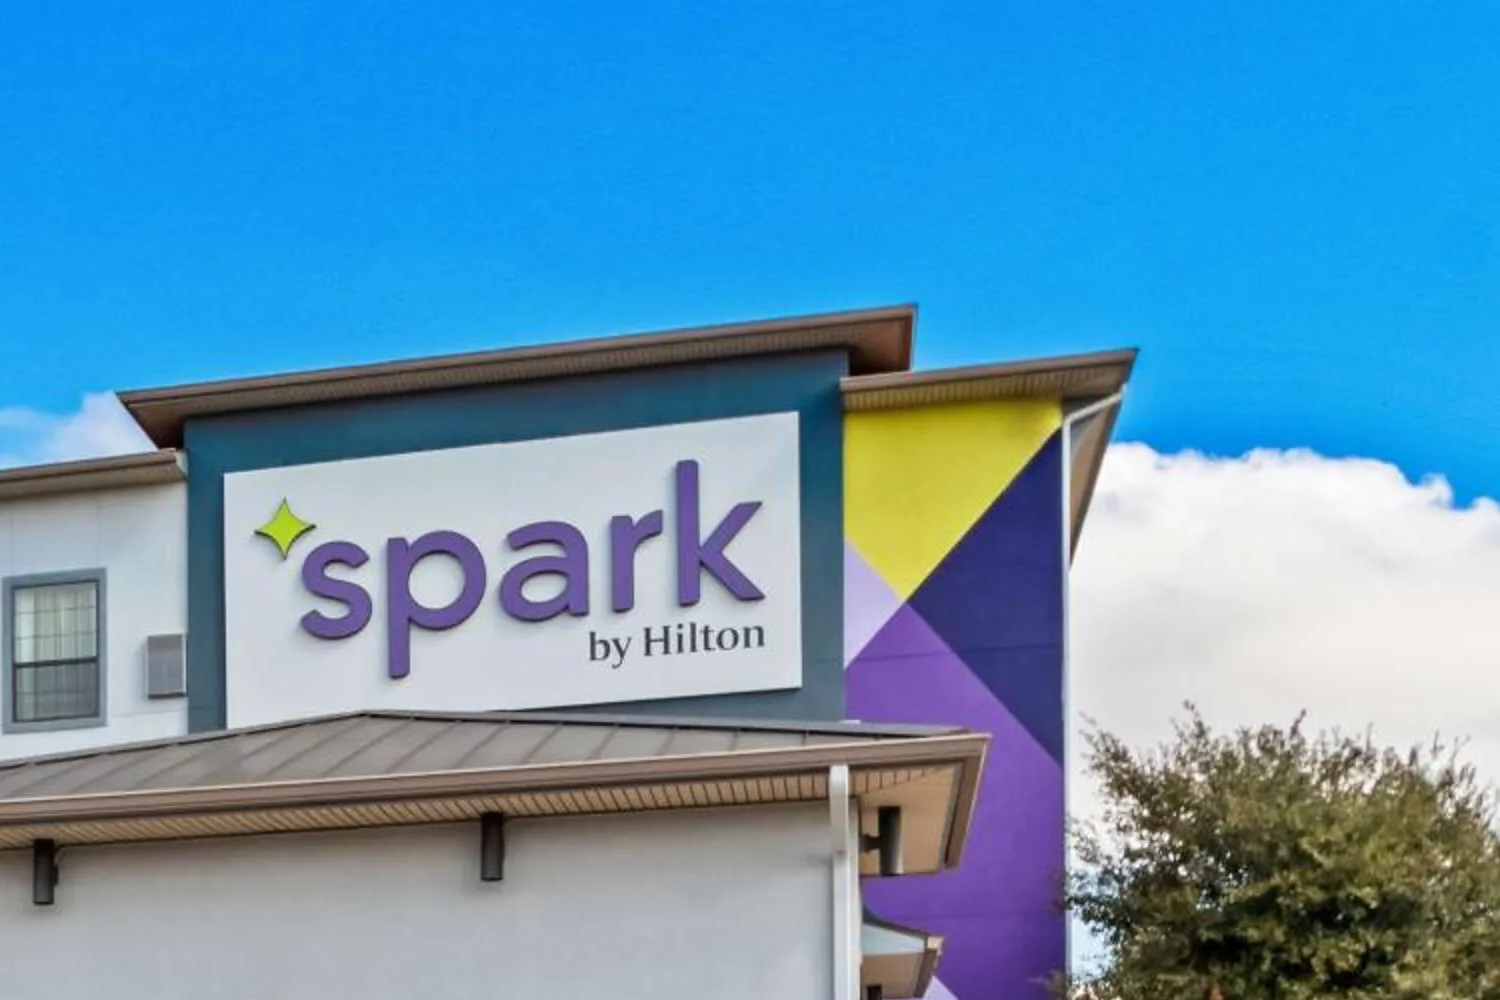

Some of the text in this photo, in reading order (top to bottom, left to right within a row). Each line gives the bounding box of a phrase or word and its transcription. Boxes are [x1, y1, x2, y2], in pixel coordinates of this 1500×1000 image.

[300, 459, 765, 679] spark
[588, 621, 765, 669] by Hilton
